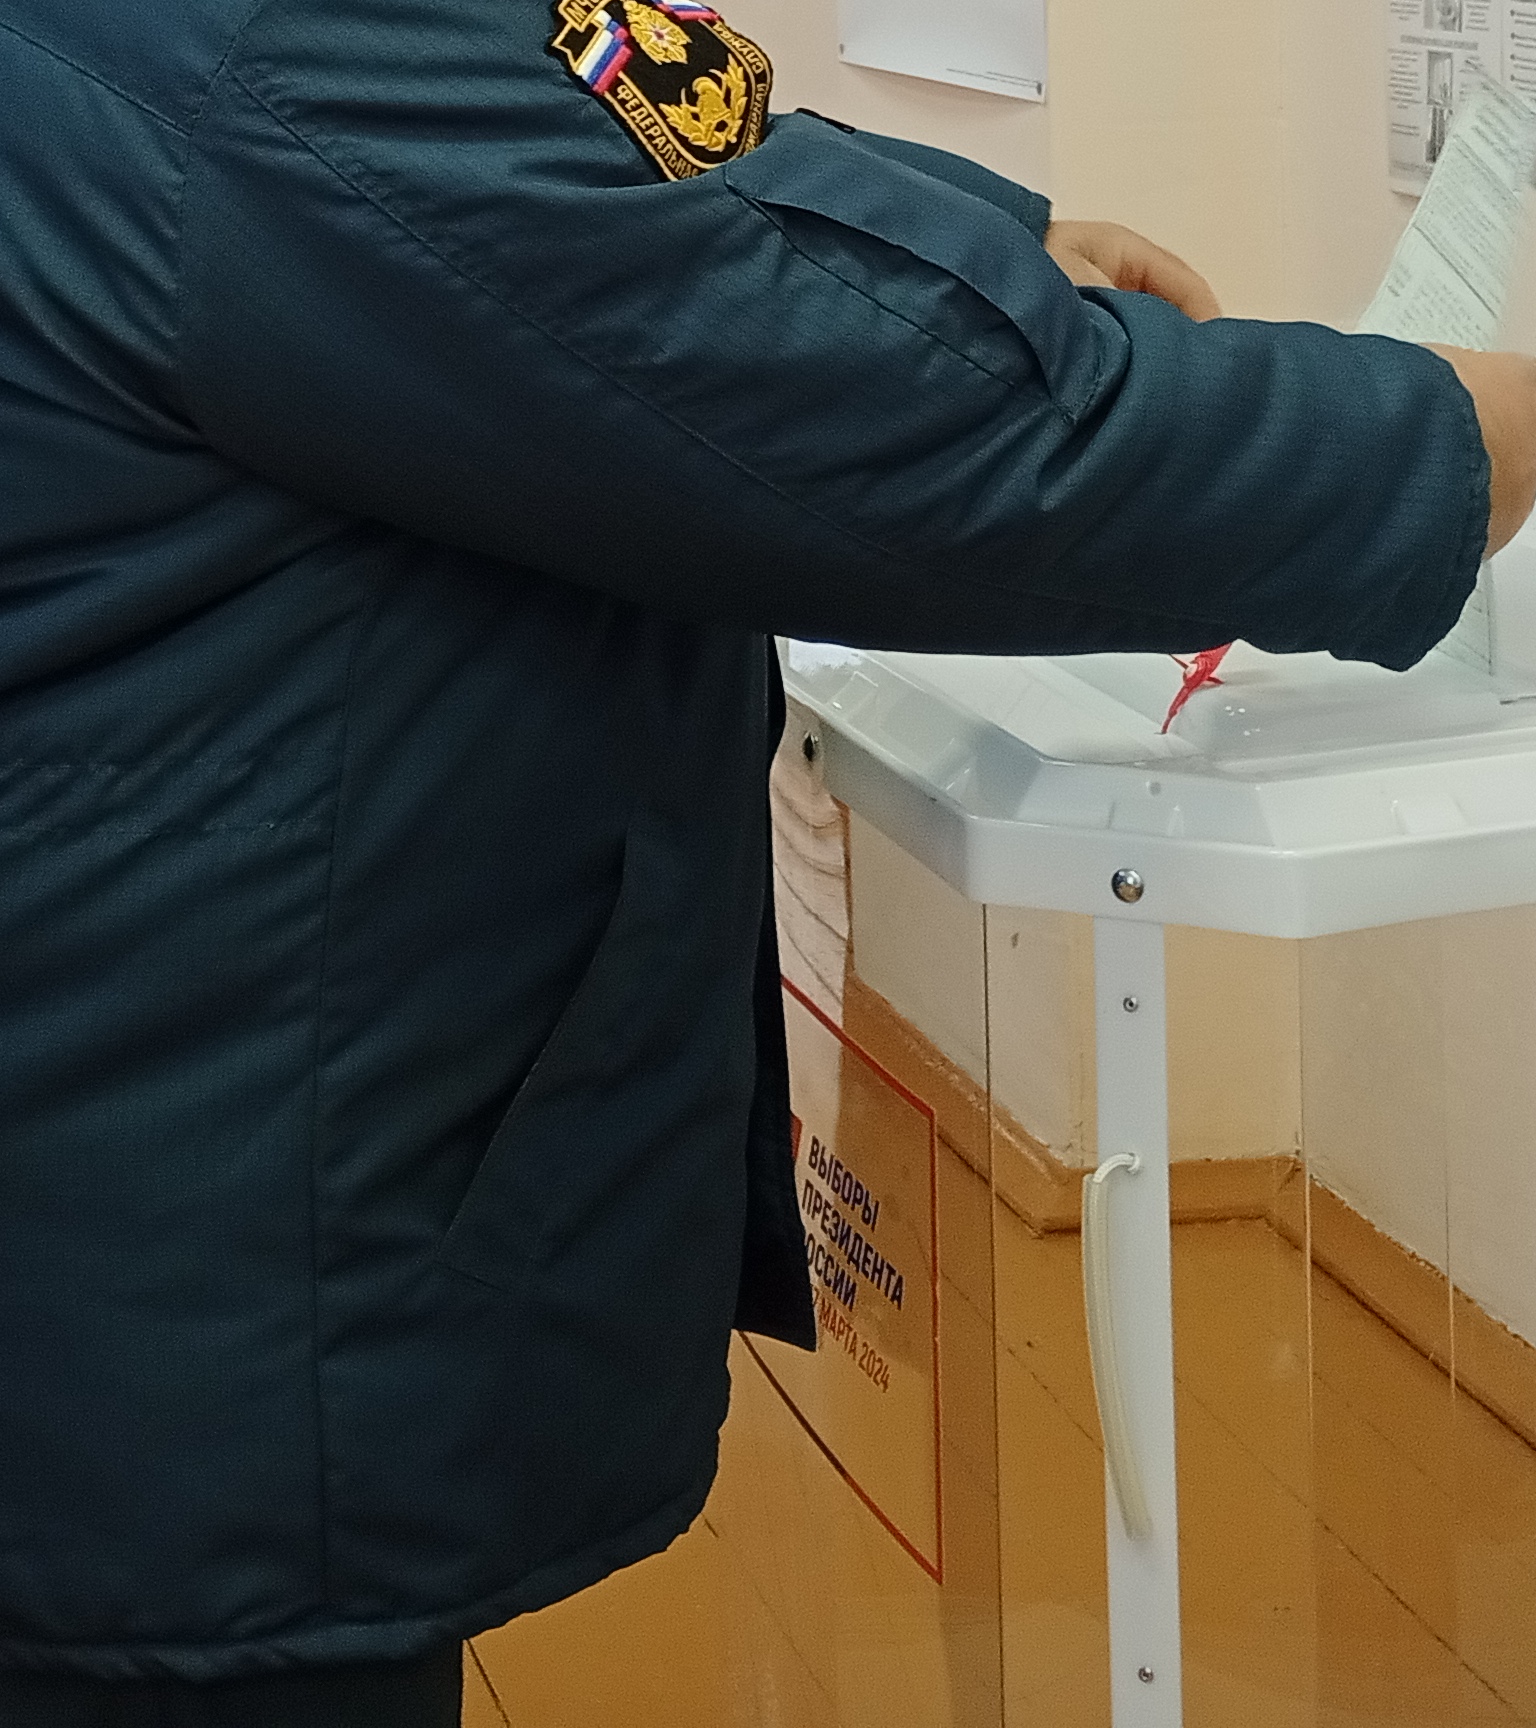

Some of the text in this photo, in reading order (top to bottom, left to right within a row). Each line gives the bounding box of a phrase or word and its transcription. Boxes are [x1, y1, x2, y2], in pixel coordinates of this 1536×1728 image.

[808, 1135, 879, 1232] ВЫБОРЫ
[802, 1179, 904, 1311] ПРЕЗИДЕНТА
[807, 1233, 857, 1312] ОССИИ
[820, 1297, 858, 1361] МАРТА
[858, 1341, 891, 1393] 2024
